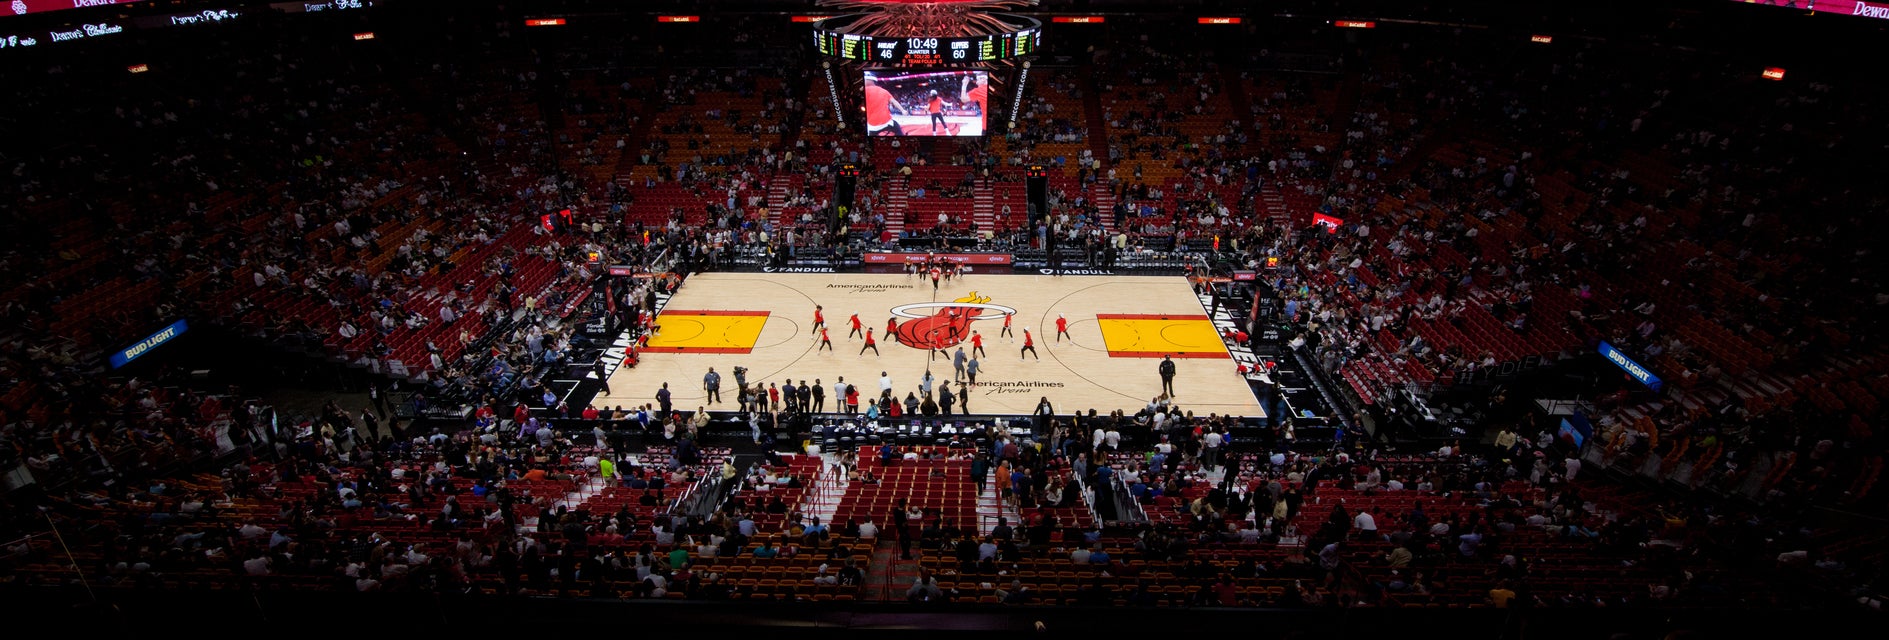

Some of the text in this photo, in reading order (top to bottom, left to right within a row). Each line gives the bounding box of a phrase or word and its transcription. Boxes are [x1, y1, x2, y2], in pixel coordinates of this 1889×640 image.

[1852, 1, 1889, 19] Dewa
[877, 41, 898, 49] HEAT
[906, 38, 938, 49] 10:49
[880, 49, 893, 59] 46
[953, 49, 966, 59] 60
[125, 327, 175, 359] BUD LIGHT
[1608, 349, 1650, 381] BUD LIGHT
[985, 386, 1031, 396] Arena
